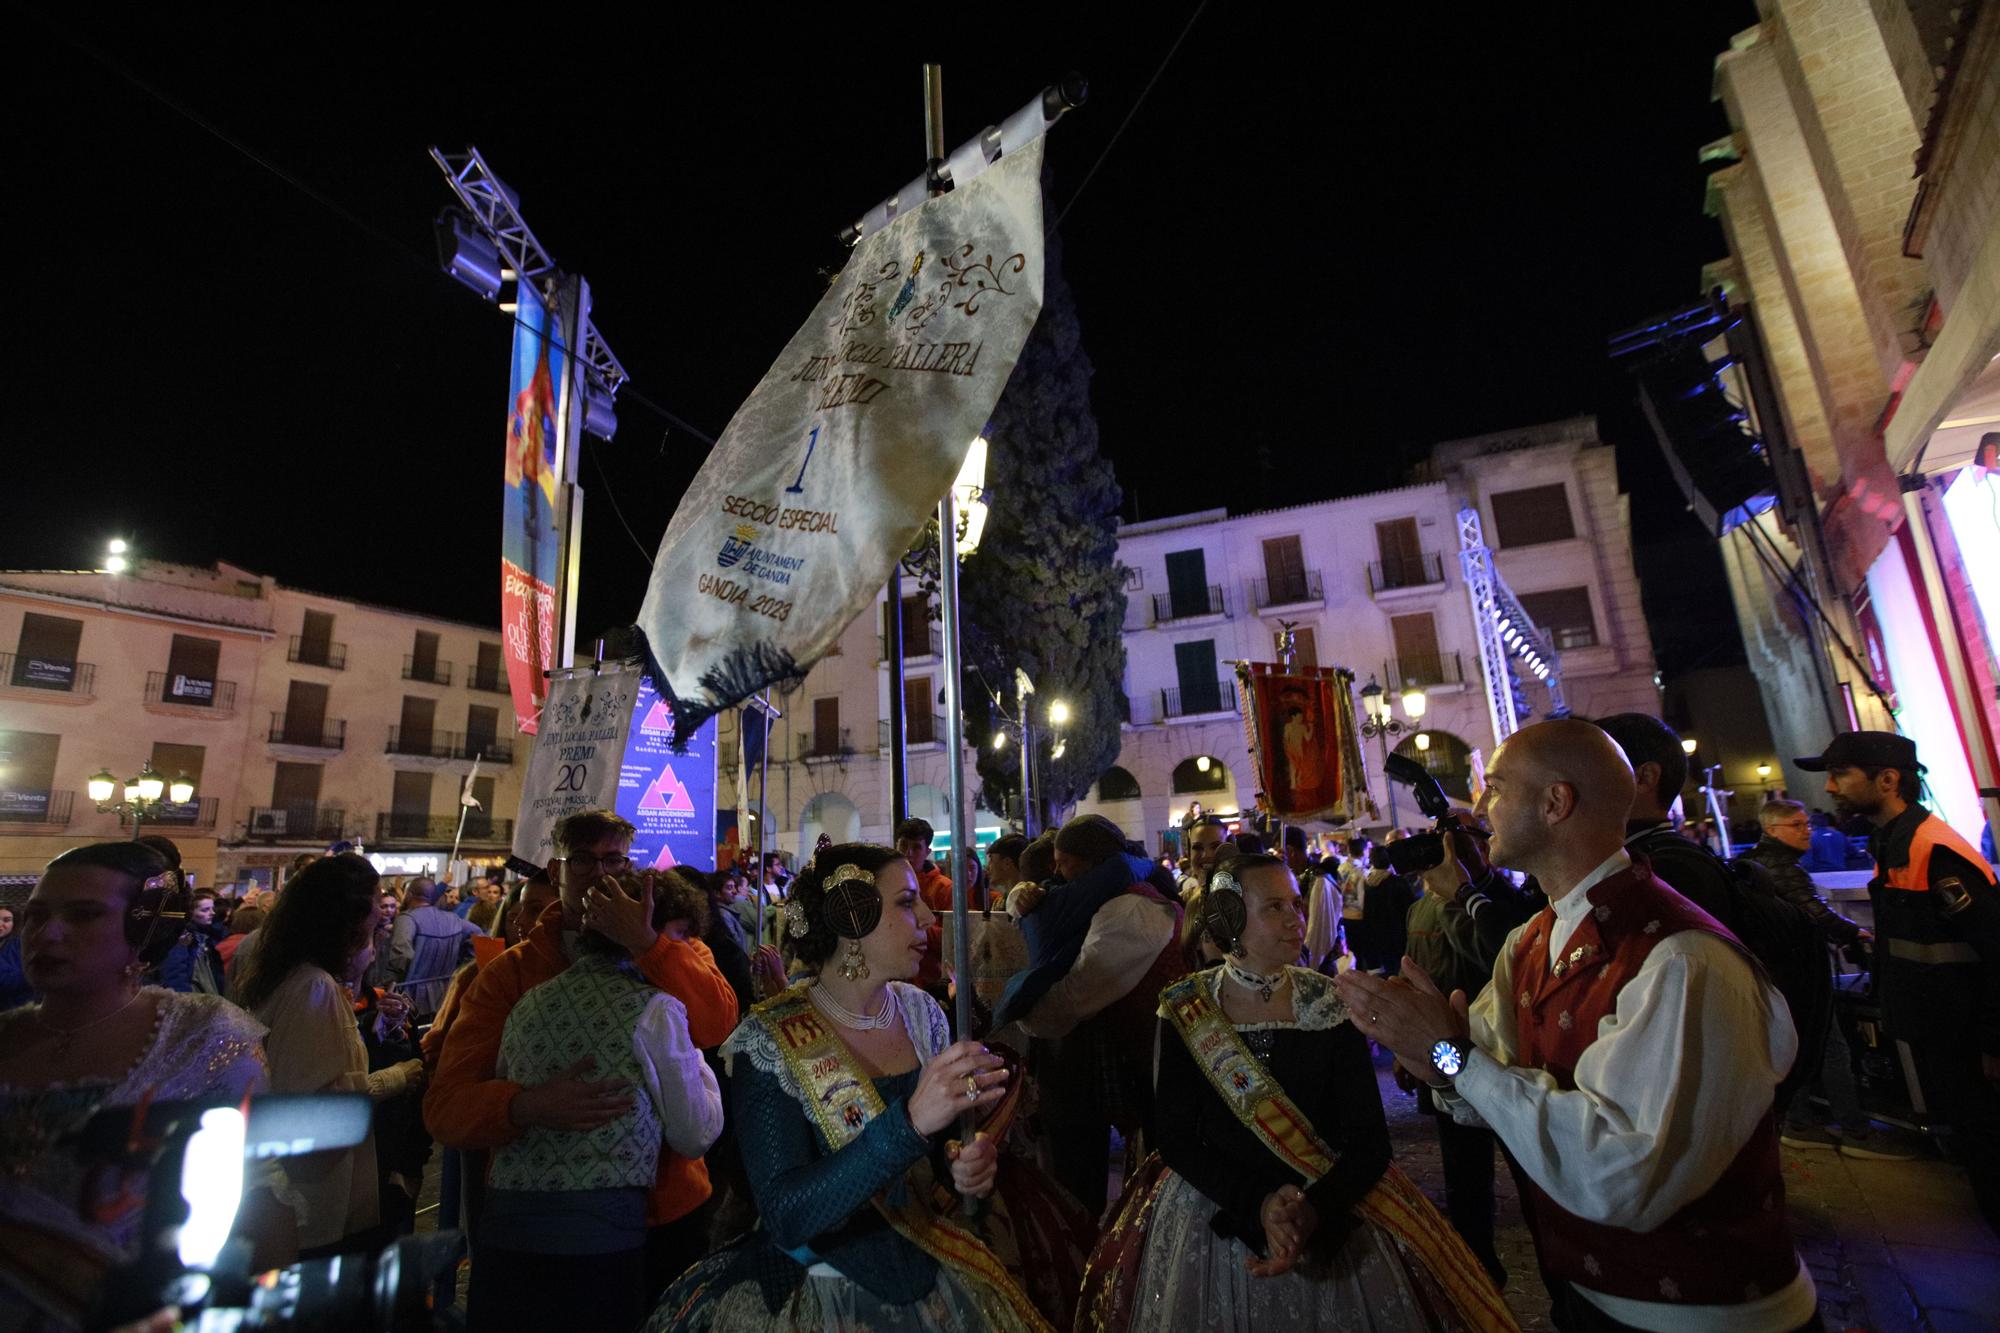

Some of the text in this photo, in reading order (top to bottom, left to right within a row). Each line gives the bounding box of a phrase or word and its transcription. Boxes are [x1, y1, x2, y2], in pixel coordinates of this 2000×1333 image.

[882, 340, 984, 376] FALLERA
[784, 424, 820, 493] 1
[722, 495, 838, 534] SECCIÓ ESPECIAL
[747, 549, 804, 571] AJUNTAMENT
[743, 561, 791, 585] DE GANDIA
[698, 573, 793, 622] GANDIA 2023
[43, 663, 72, 674] Venta
[565, 731, 587, 744] LOCAL
[587, 727, 619, 742] FALLERA
[559, 745, 597, 762] PREMI
[554, 764, 587, 792] 20
[17, 792, 46, 803] Venta
[532, 796, 563, 810] FESTIVAL
[811, 1055, 840, 1079] 2023
